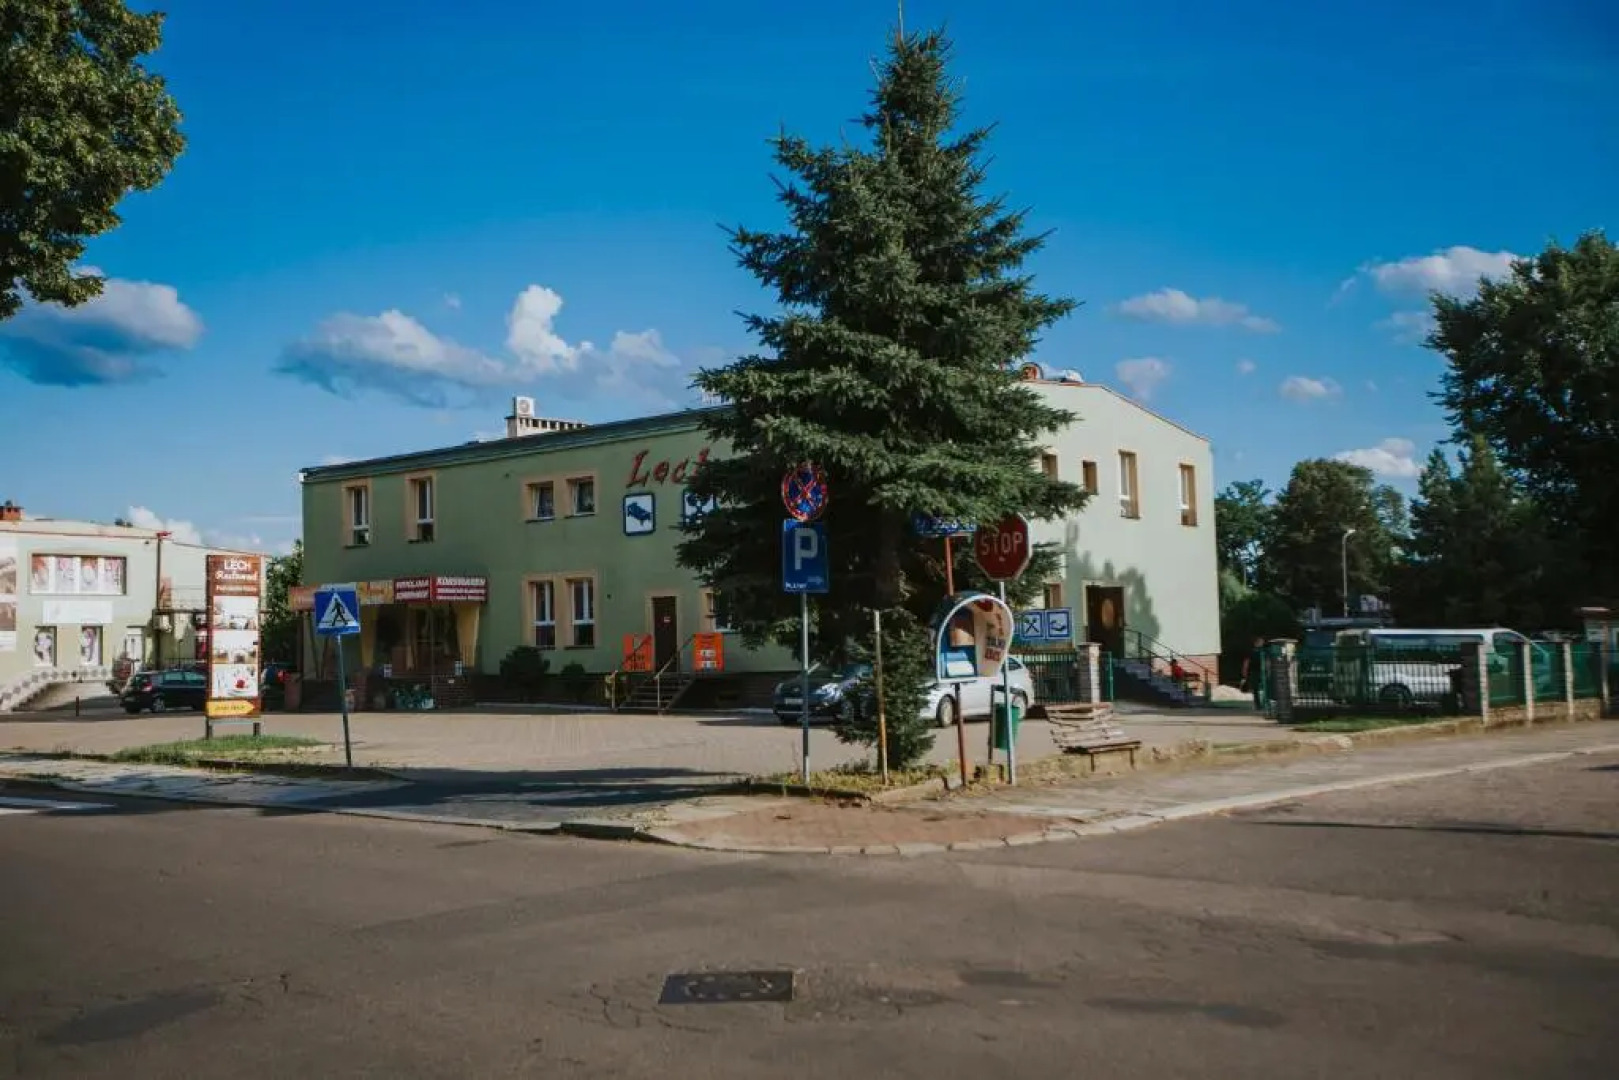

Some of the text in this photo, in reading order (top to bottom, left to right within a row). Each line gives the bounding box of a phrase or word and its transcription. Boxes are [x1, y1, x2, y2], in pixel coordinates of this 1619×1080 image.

[794, 528, 818, 570] P
[980, 531, 1024, 556] STOP
[224, 559, 252, 571] LECH
